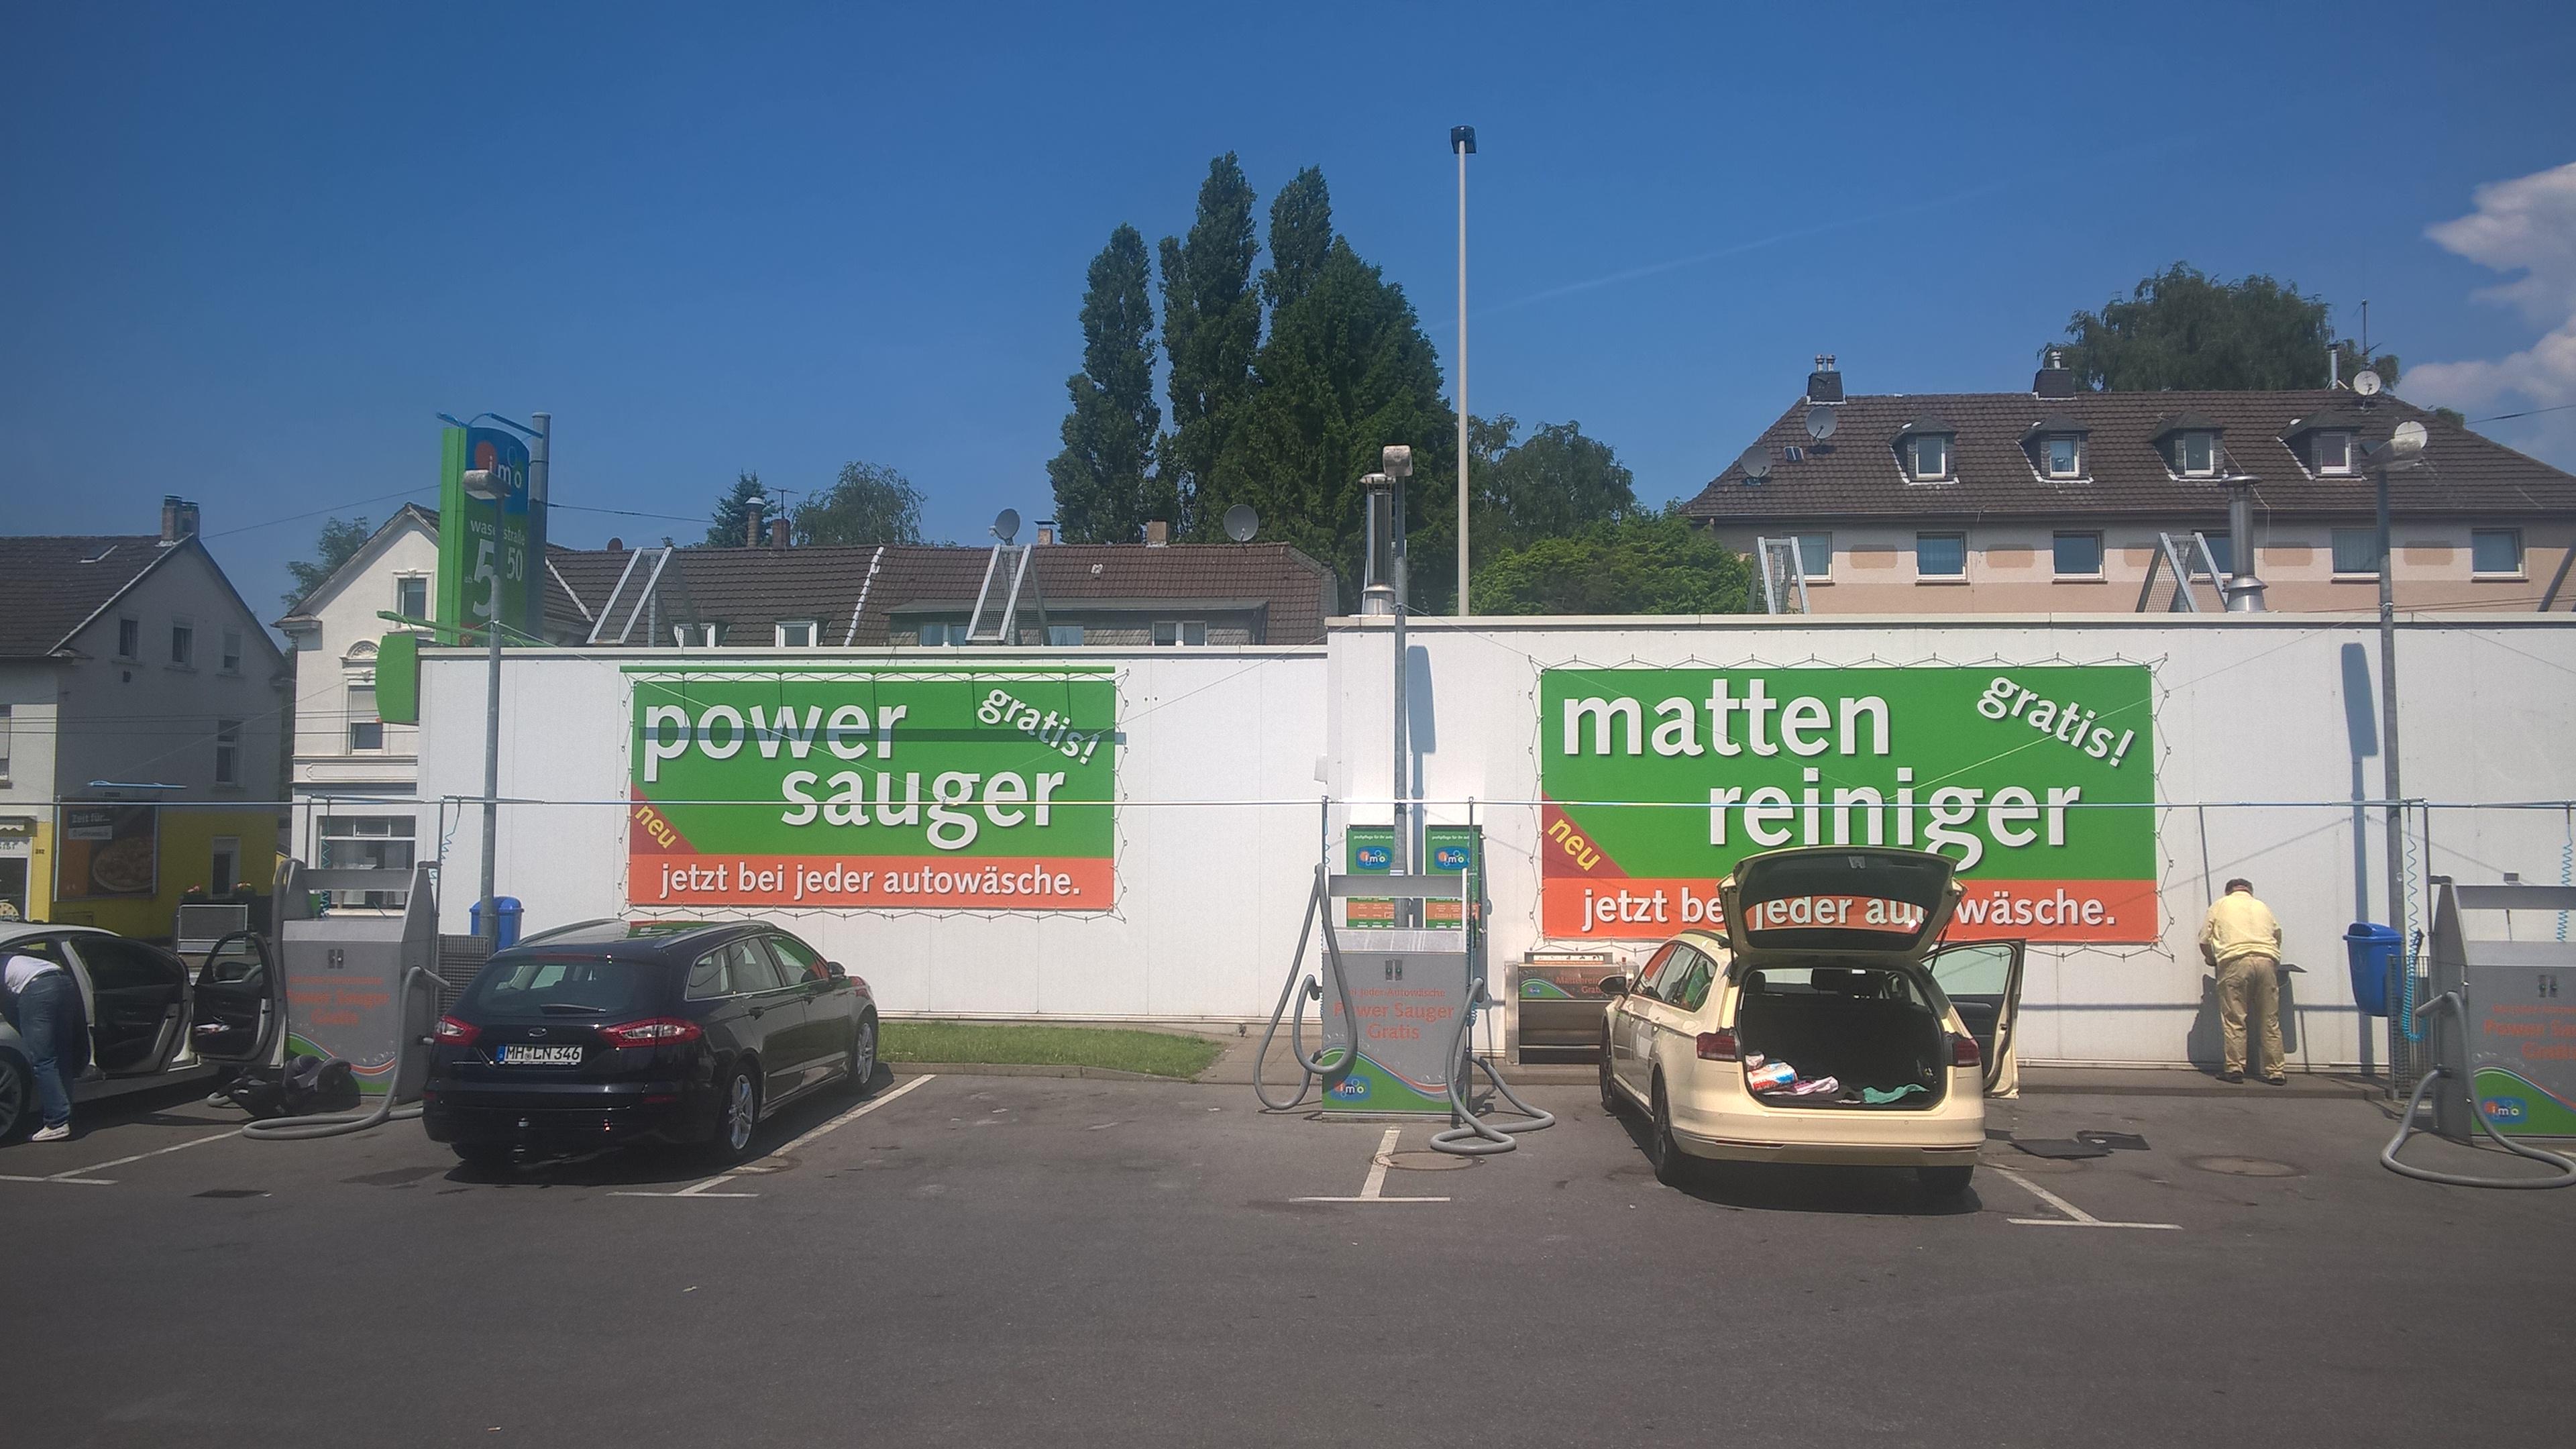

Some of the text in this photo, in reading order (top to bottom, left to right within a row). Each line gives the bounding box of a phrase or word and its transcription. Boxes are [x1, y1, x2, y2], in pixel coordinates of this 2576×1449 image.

[506, 547, 523, 582] 50
[977, 688, 1102, 765] gratis!
[1564, 678, 1890, 757] matten
[1976, 676, 2136, 767] gratis!
[643, 704, 908, 782] power
[634, 803, 677, 849] neu
[781, 770, 1066, 849] sauger
[1709, 767, 2082, 872] reiniger
[1364, 853, 1386, 863] imo
[1443, 853, 1464, 863] imo
[1548, 816, 1602, 871] neu
[659, 862, 1081, 900] jetzt bei jeder autowäsche.
[1581, 890, 1668, 933] jetzt
[1681, 887, 1725, 924] be
[1334, 1002, 1454, 1022] Pwer Sauger
[1366, 1022, 1421, 1039] Gratis
[506, 1046, 580, 1060] MH LN 346
[1340, 1083, 1364, 1094] imo
[2492, 1106, 2520, 1116] imo
